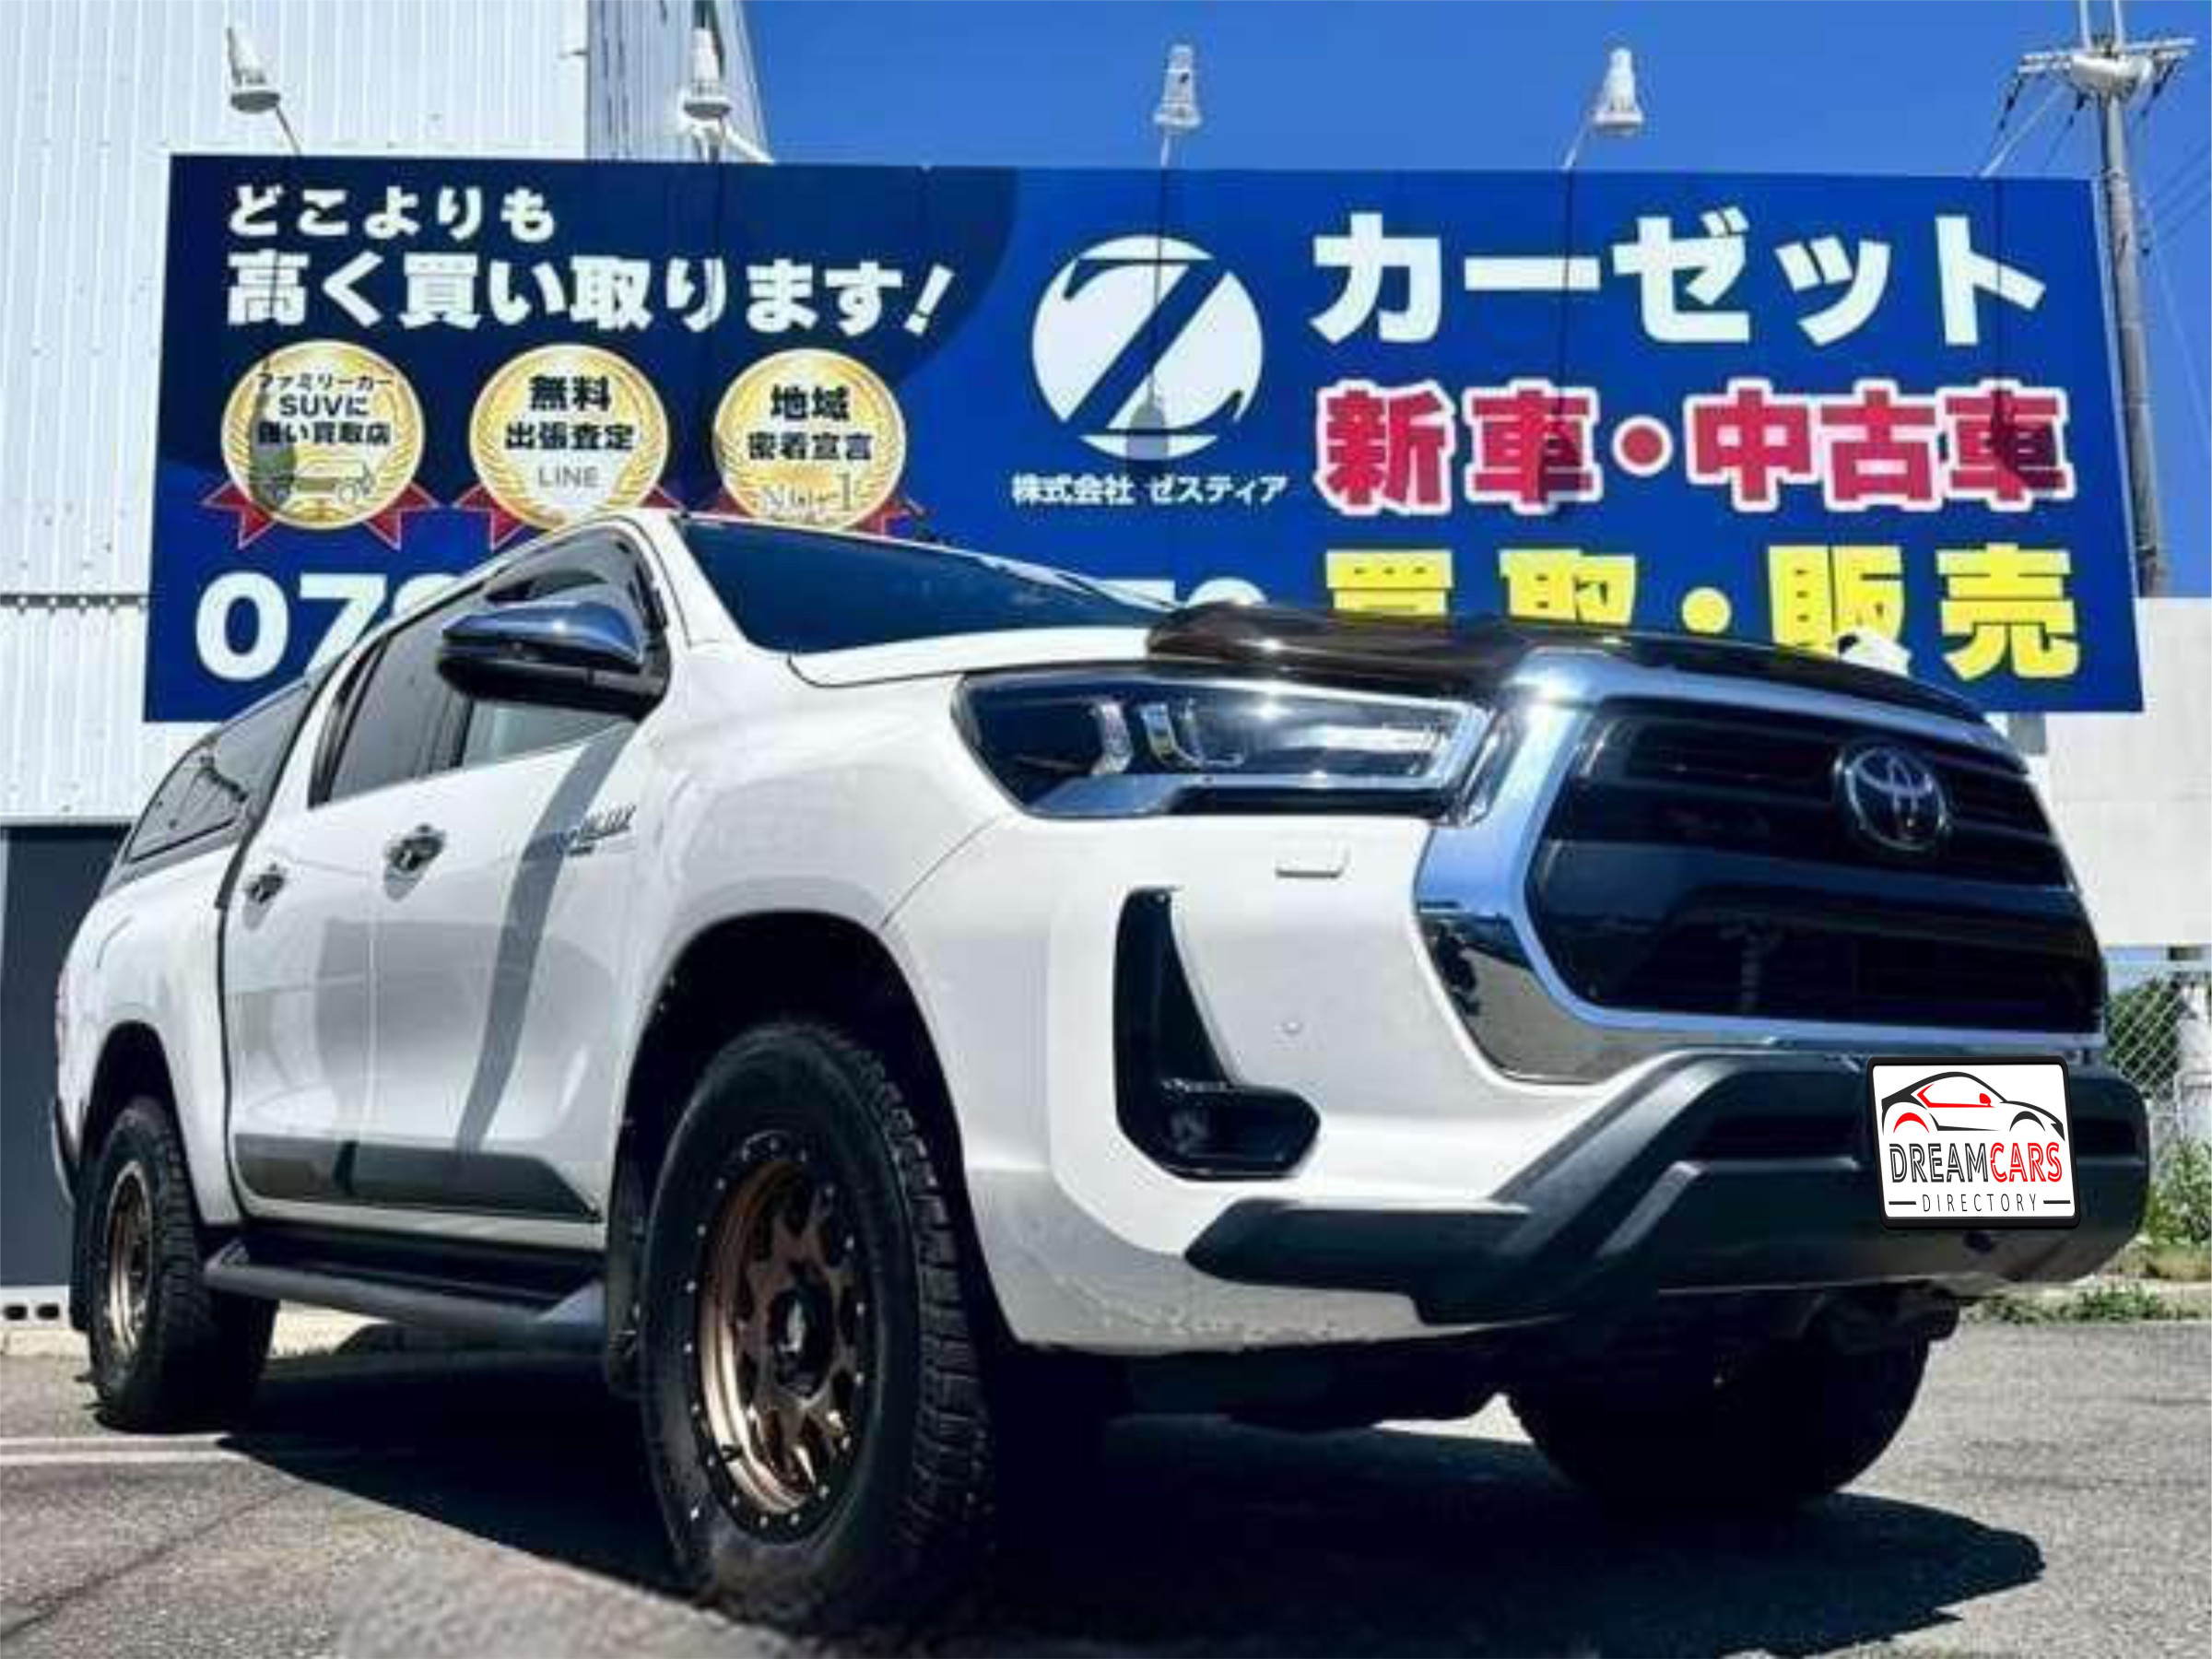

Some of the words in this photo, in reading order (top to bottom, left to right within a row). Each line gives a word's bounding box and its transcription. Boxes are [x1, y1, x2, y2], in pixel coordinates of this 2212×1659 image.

[229, 184, 554, 243] どこよりも
[227, 249, 956, 336] 高く買い取ります!
[1309, 206, 2047, 347] カーゼット
[278, 394, 370, 417] SUVに
[528, 375, 611, 412] 無料
[771, 382, 850, 421] 地域
[506, 420, 633, 451] 出張査定
[747, 431, 873, 461] 密着宣言
[1314, 379, 2076, 515] 新車・中古車
[537, 465, 598, 488] LINE
[1011, 473, 1135, 506] 株式会社
[1144, 473, 1289, 506] ゼスティア
